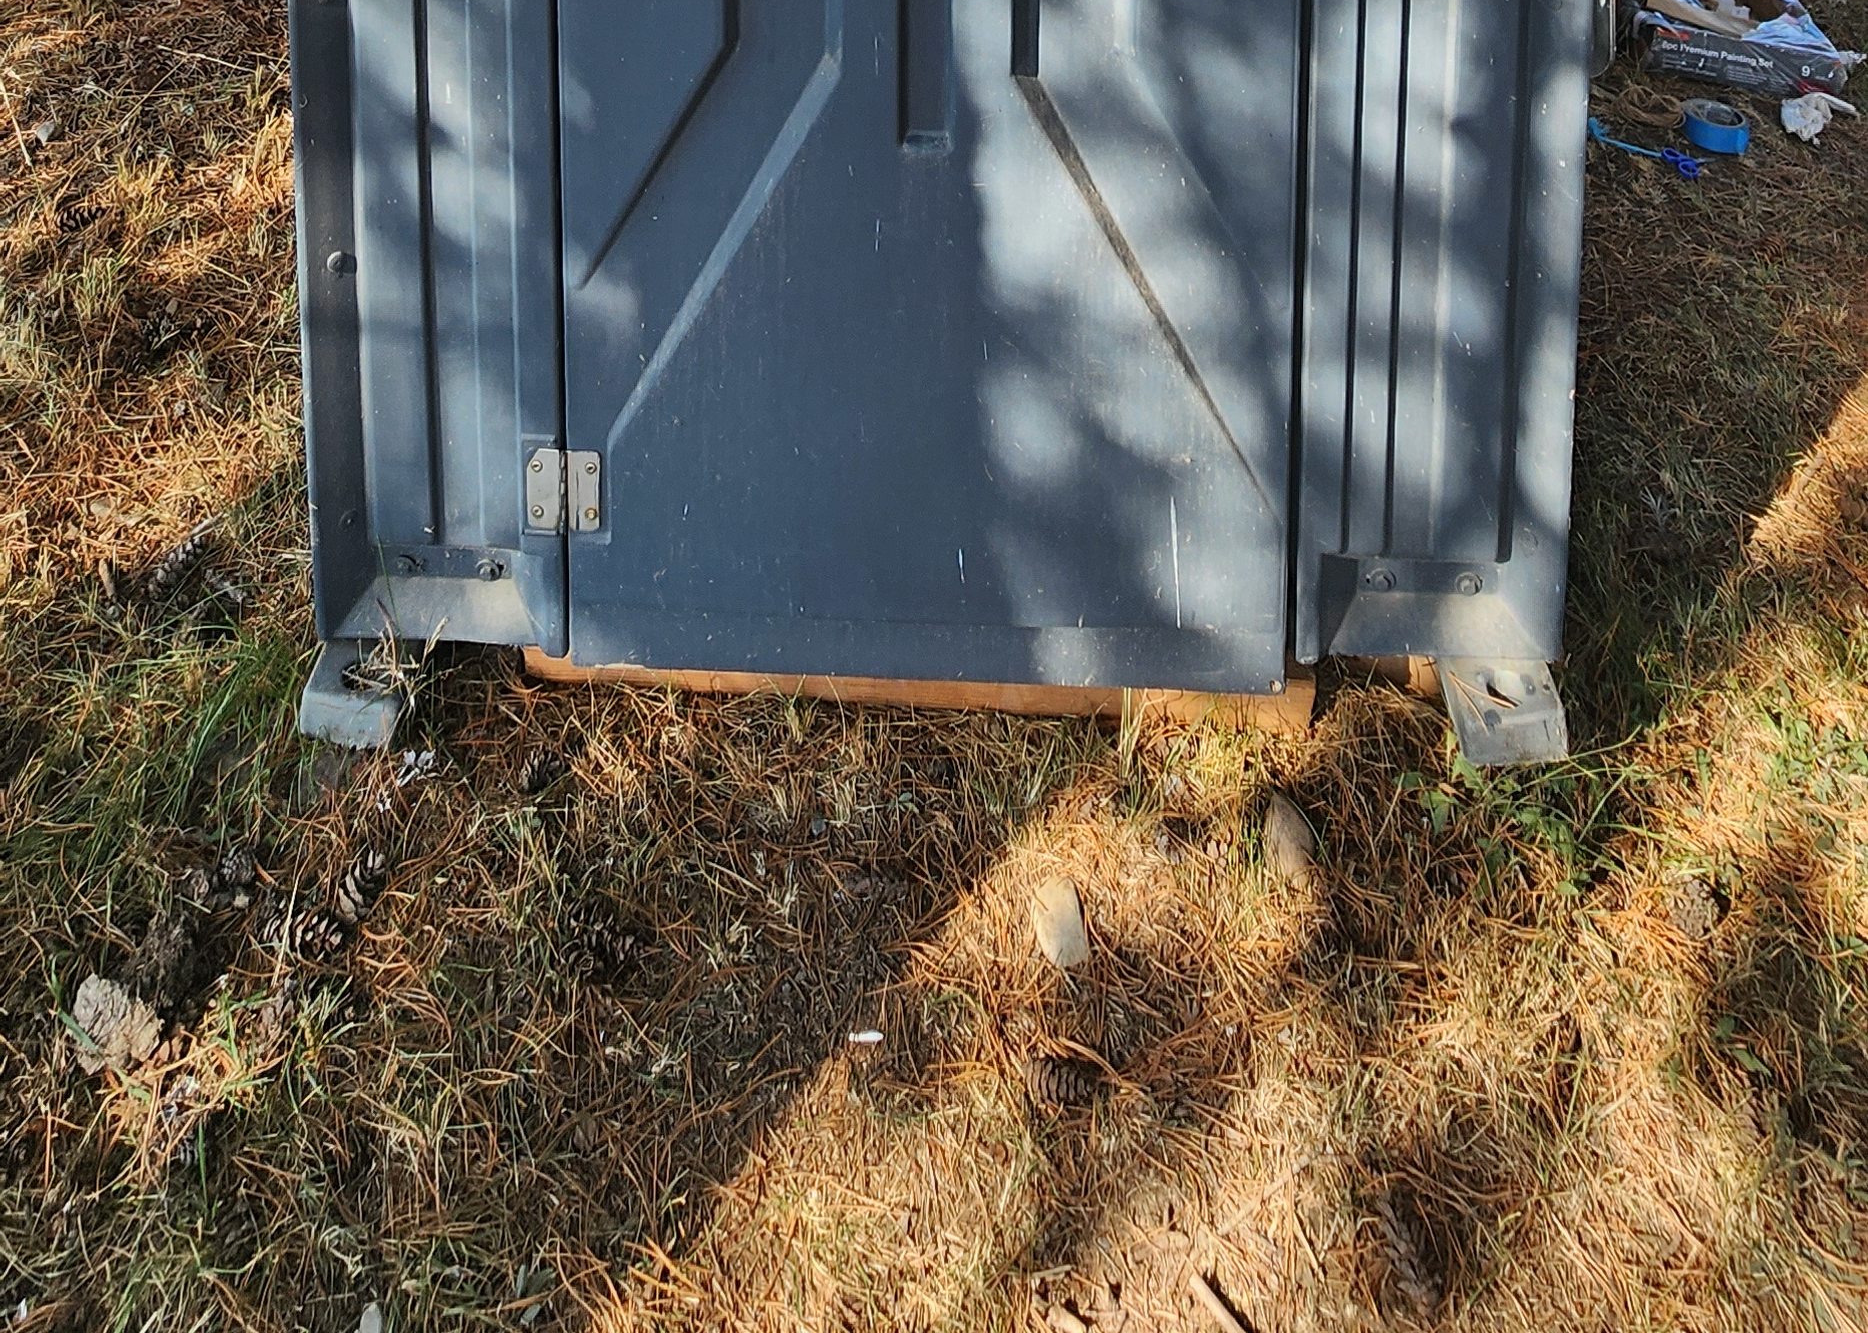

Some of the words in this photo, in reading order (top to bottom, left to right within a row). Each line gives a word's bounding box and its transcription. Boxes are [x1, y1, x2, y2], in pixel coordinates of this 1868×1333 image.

[1680, 43, 1719, 58] Premium
[1720, 51, 1757, 67] Painting
[1758, 58, 1774, 68] Set
